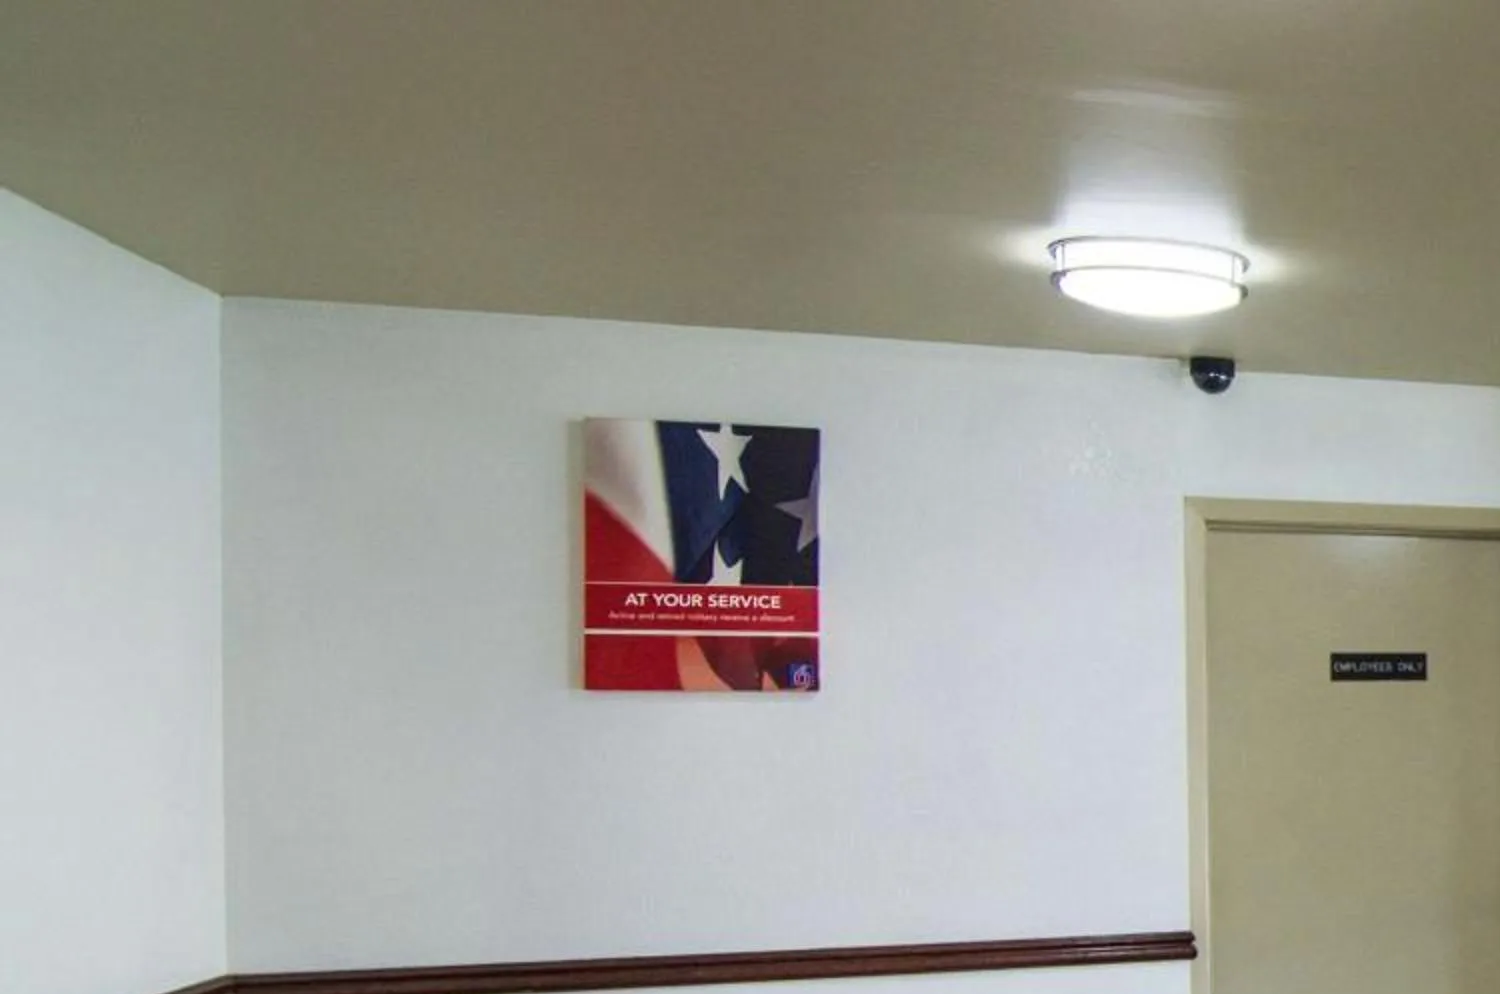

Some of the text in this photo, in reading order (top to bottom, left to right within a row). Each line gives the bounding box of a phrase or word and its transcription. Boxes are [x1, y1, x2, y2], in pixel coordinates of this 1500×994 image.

[624, 592, 782, 609] AT YOUR SERVICE
